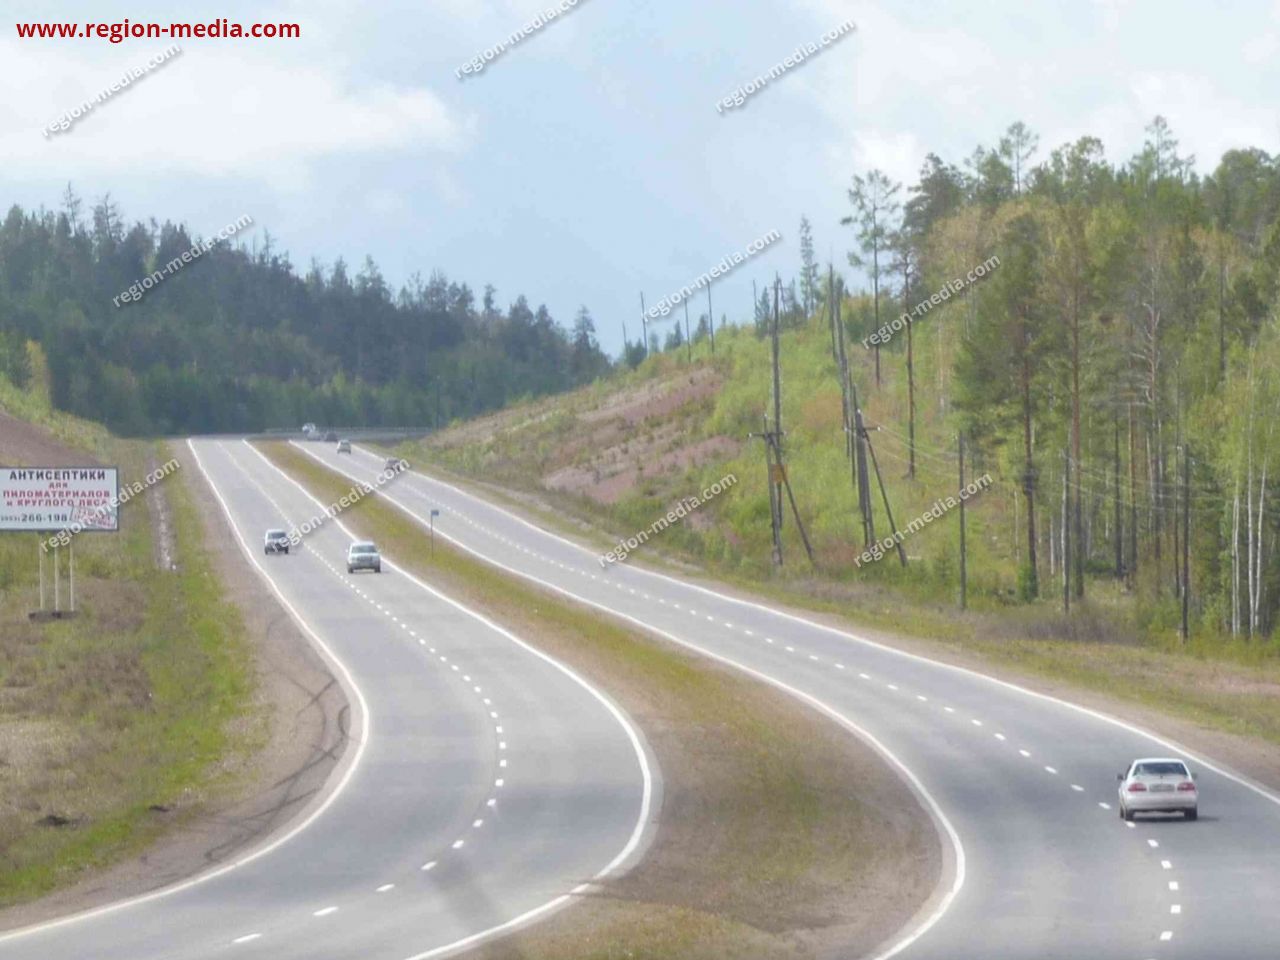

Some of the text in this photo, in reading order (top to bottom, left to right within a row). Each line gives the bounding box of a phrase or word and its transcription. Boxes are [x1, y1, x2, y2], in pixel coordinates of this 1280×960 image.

[10, 470, 105, 480] АНТИСЕПТИКИ
[3, 490, 110, 498] ПИЛОМАТЕРИАЛОВ
[17, 499, 74, 507] КРУГЛОГО
